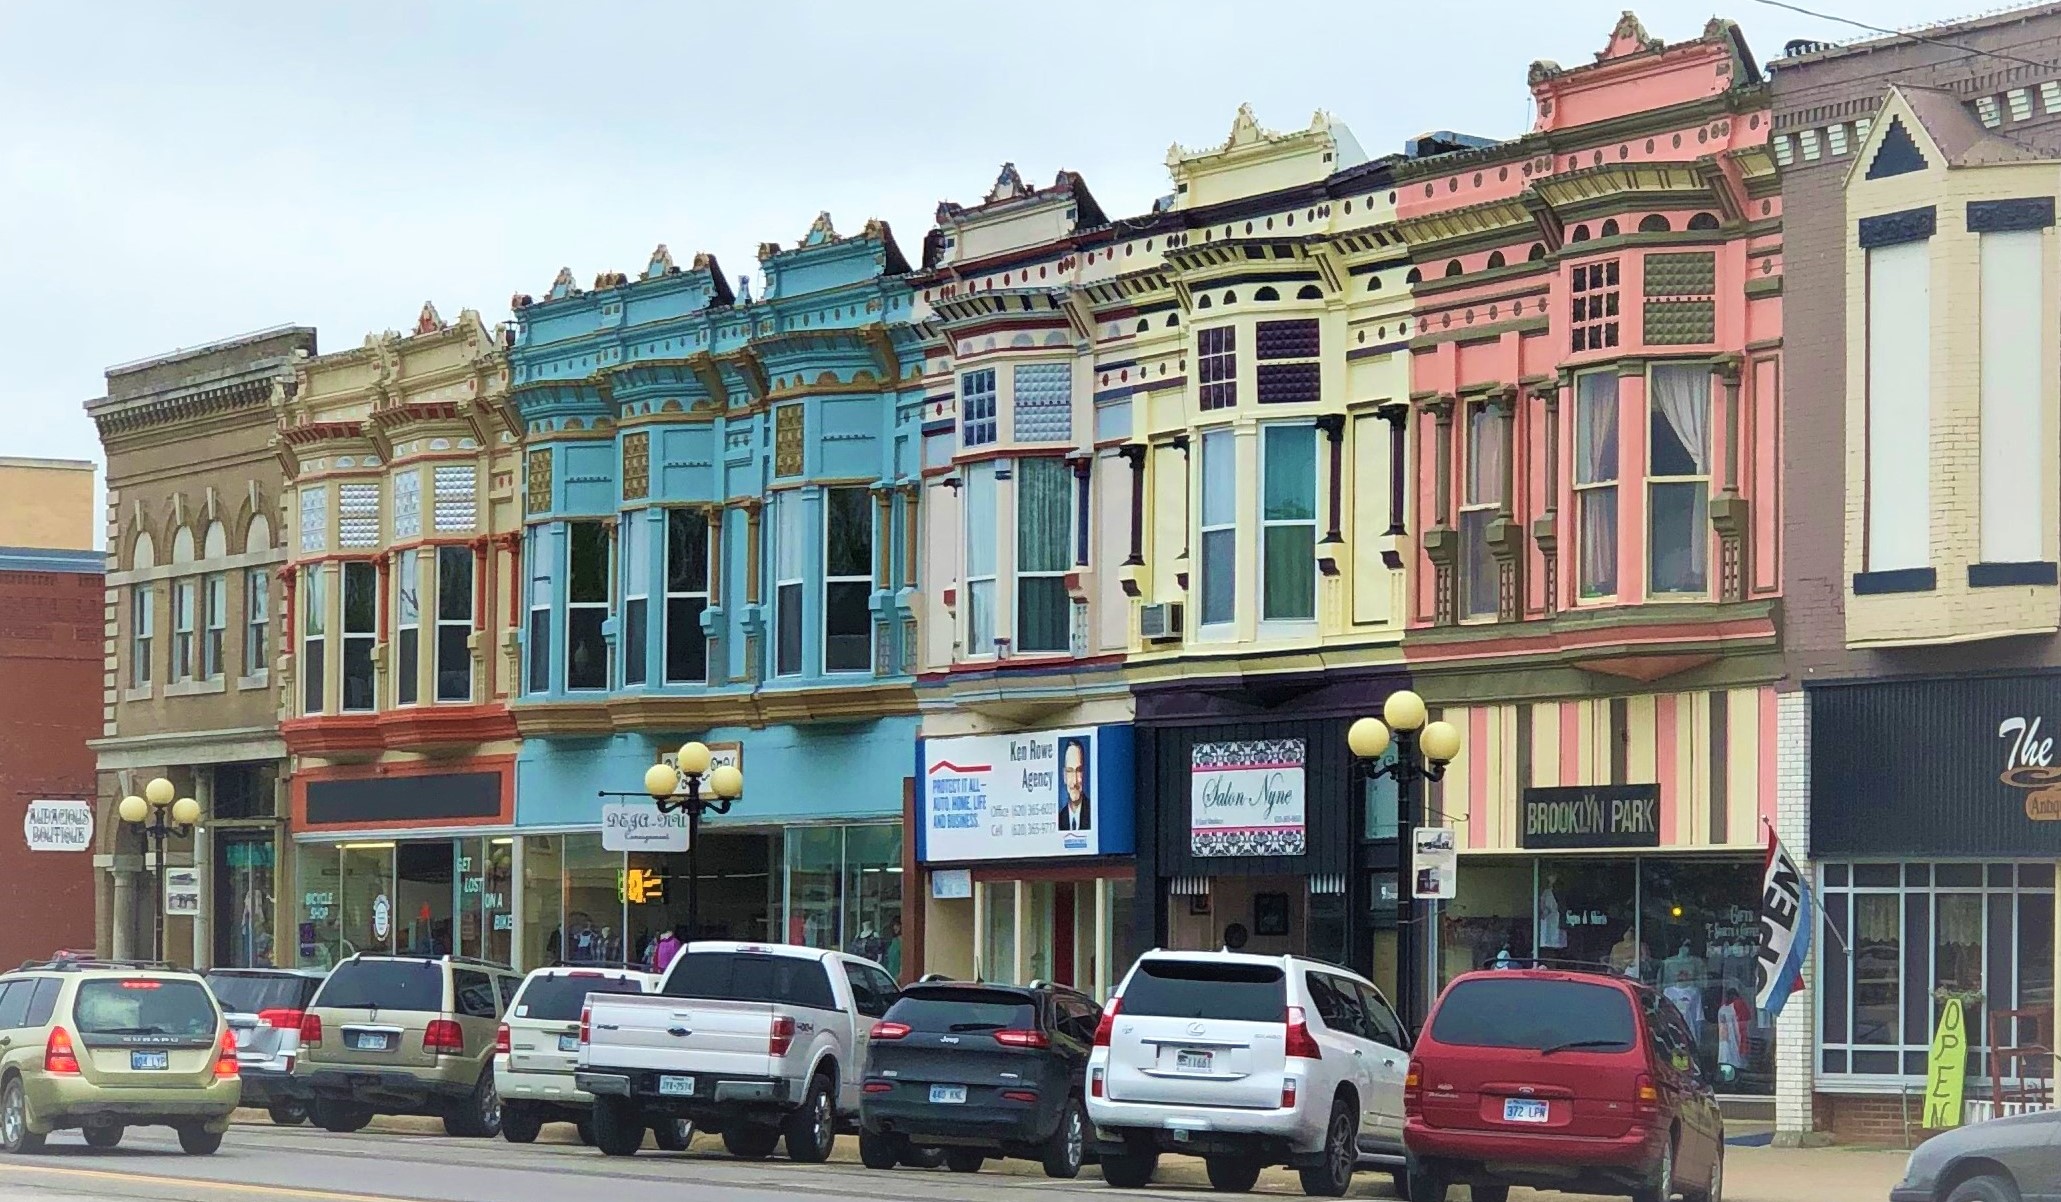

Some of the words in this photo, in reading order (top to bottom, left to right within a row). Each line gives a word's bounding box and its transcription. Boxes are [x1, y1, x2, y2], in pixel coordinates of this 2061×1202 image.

[1010, 741, 1027, 761] Ken
[1030, 740, 1053, 760] Rowe
[1999, 716, 2053, 770] The
[933, 779, 960, 793] PROTECT
[1022, 767, 1053, 792] Agency
[1203, 774, 1245, 814] Salon
[1249, 772, 1293, 820] Nyne
[29, 808, 89, 825] AUDACIOUS
[1527, 794, 1604, 834] BROOKLYN
[1611, 799, 1655, 833] PARK
[32, 826, 84, 844] BOUTIQUE
[457, 857, 472, 872] GET
[464, 877, 484, 892] LOST
[940, 1035, 959, 1044] Jeep
[1931, 1001, 1960, 1127] OPEN
[1507, 1105, 1523, 1117] 372
